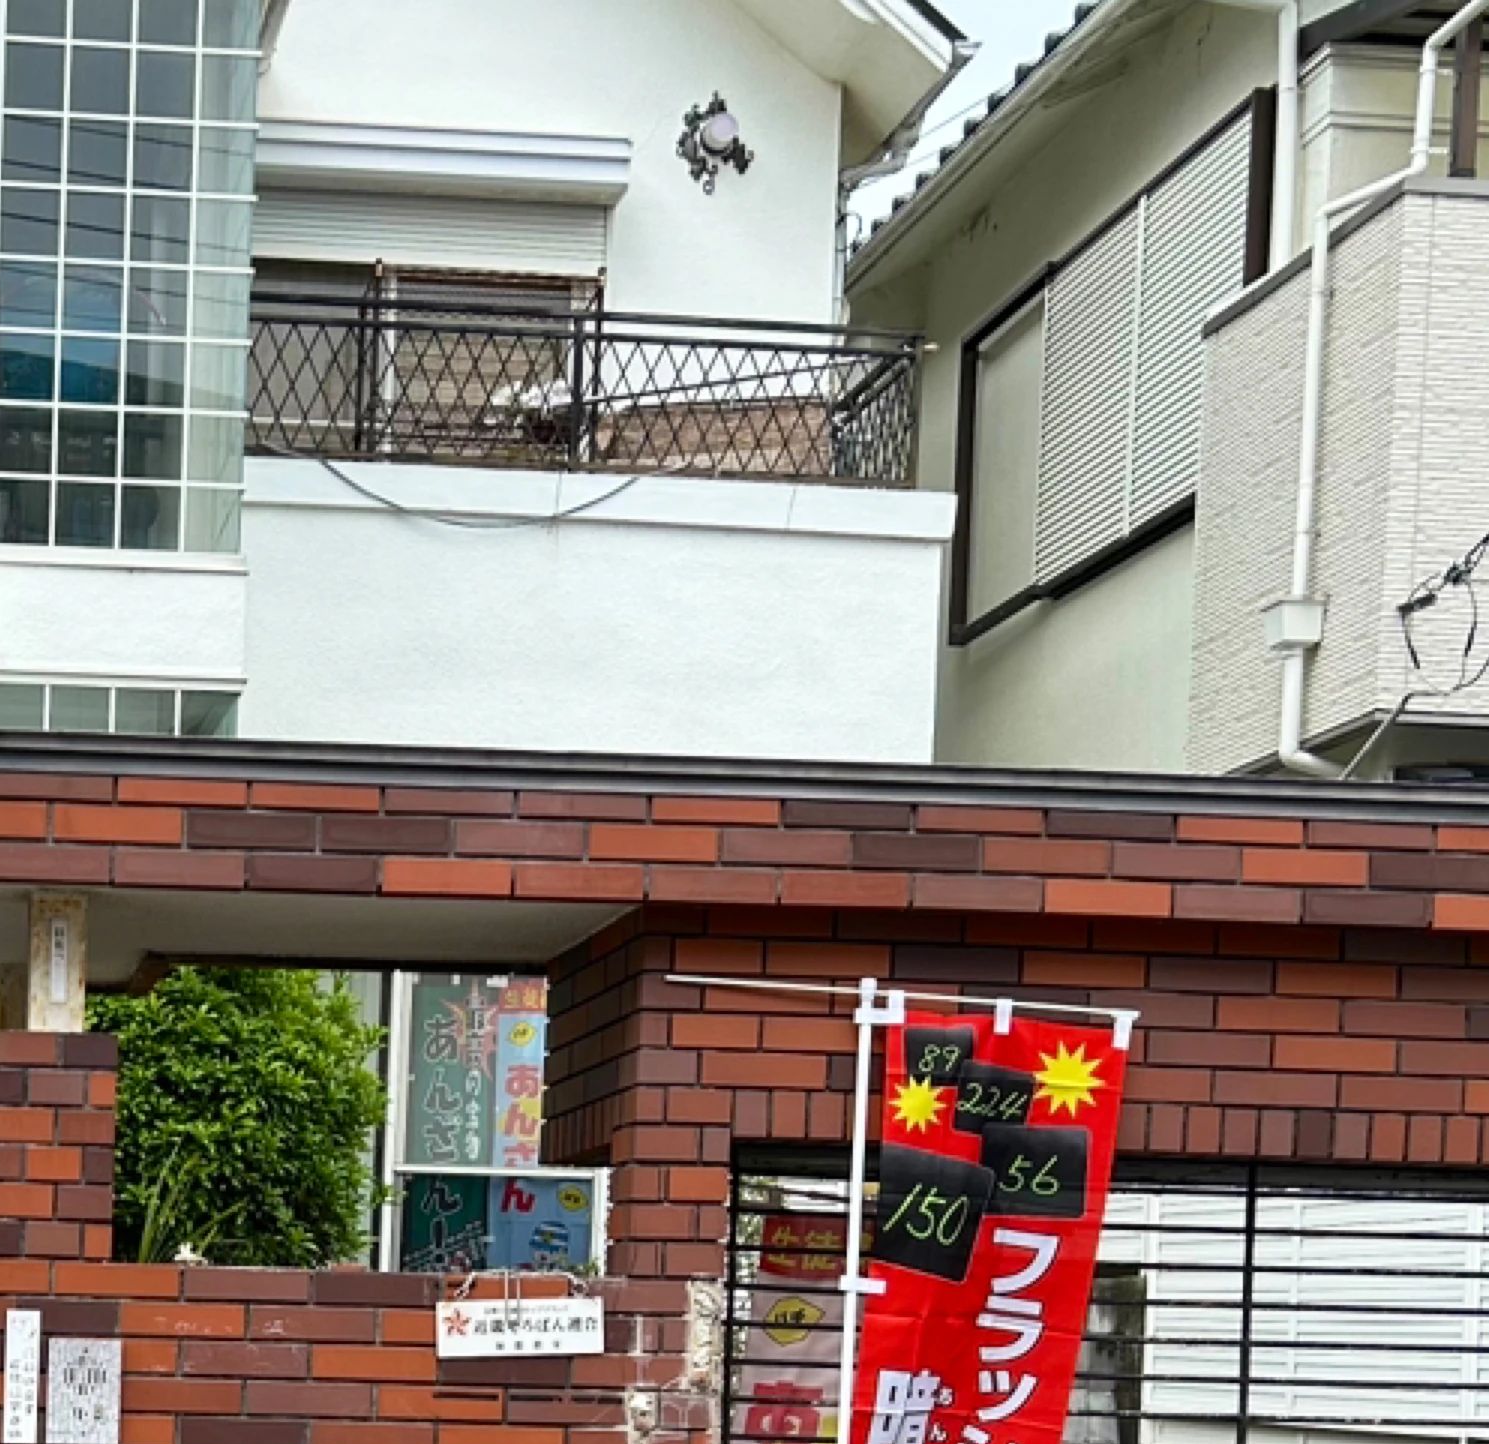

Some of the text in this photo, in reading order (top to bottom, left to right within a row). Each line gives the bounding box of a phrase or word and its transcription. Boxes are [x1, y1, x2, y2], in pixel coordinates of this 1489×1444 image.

[918, 1044, 961, 1072] 89
[956, 1082, 1028, 1121] 224
[999, 1154, 1059, 1194] 56
[882, 1182, 968, 1245] 150
